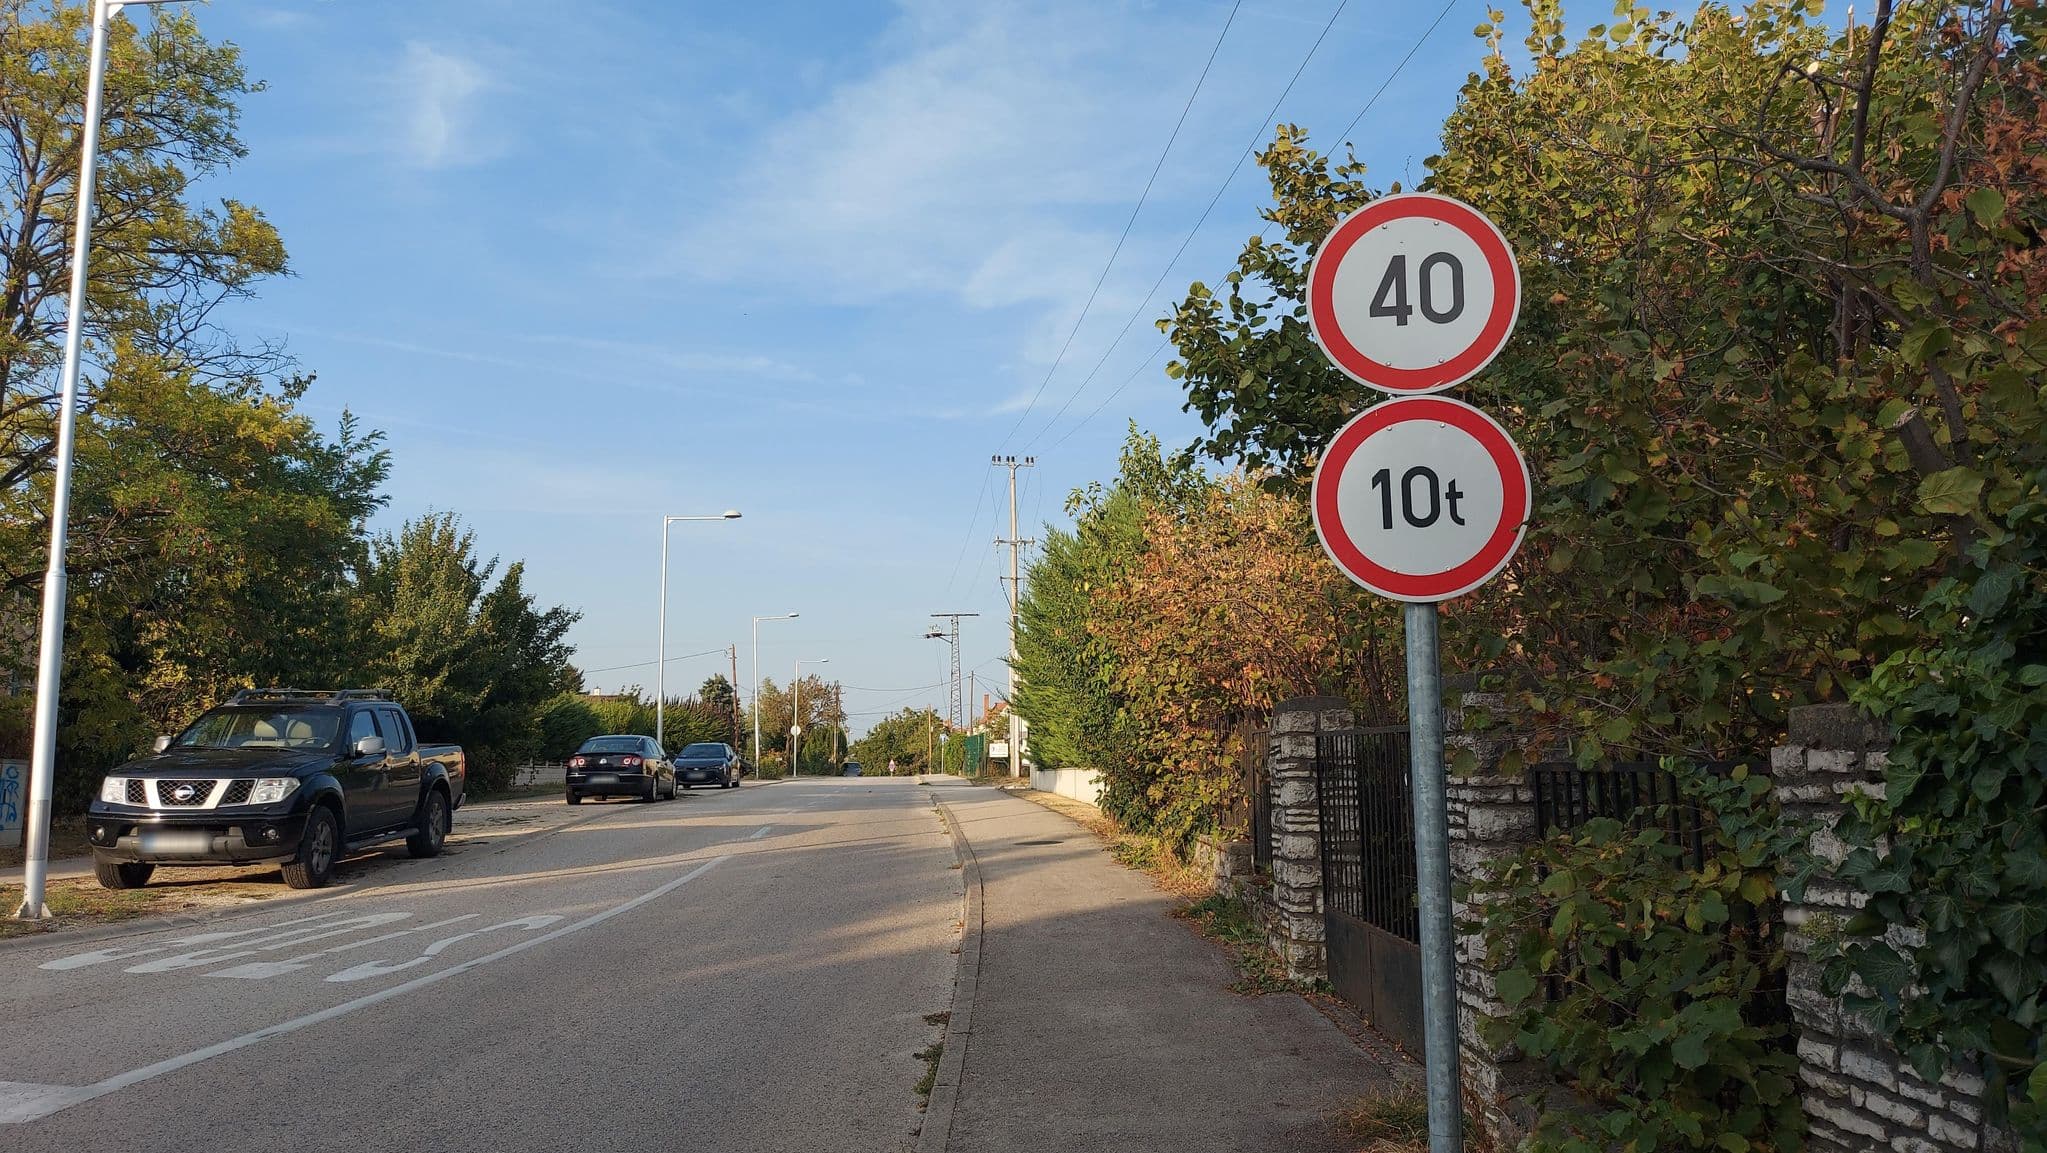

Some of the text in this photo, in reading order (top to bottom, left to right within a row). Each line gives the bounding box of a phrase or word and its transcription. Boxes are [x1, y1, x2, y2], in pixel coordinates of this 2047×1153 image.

[1369, 251, 1466, 327] 40
[1371, 465, 1466, 530] 10t
[38, 909, 565, 982] STOP
